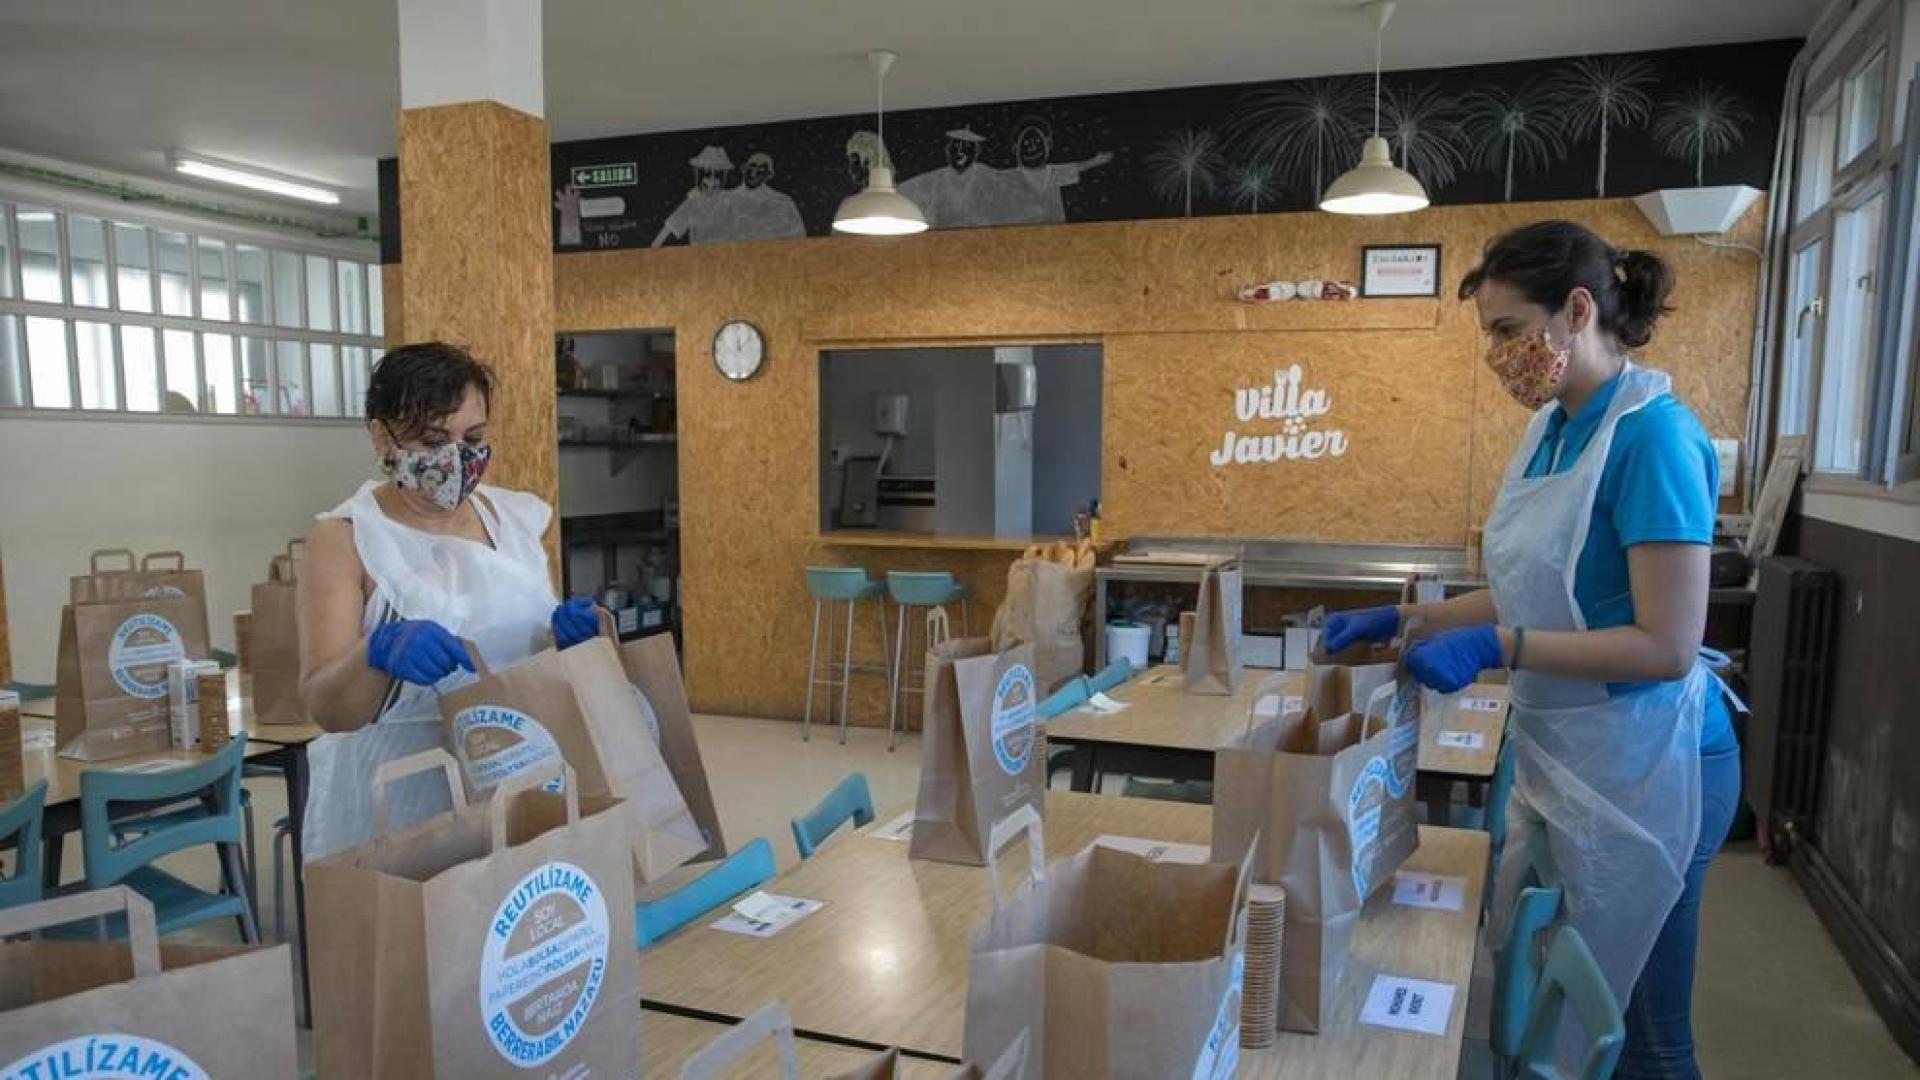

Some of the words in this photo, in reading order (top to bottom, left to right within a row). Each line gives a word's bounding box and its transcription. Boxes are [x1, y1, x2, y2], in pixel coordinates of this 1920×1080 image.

[592, 167, 633, 182] SALIDA
[1235, 364, 1332, 422] Villa
[1209, 430, 1349, 466] Javier
